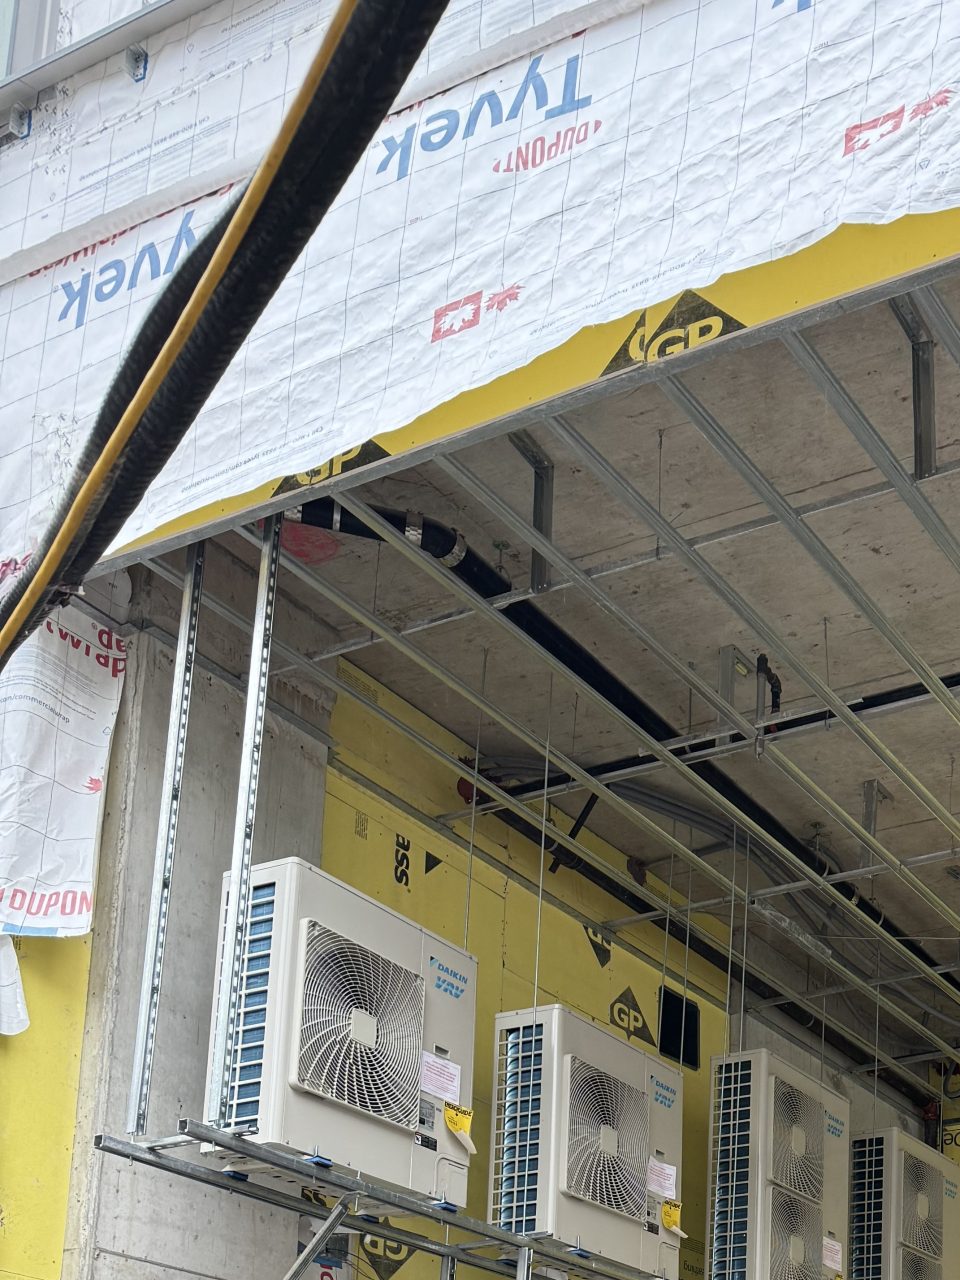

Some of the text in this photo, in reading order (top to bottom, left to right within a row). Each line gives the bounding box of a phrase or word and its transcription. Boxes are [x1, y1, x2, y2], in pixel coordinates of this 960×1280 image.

[375, 54, 596, 181] Tyvek
[501, 123, 589, 174] DUPONT
[58, 209, 199, 329] yvek
[647, 315, 723, 363] GP
[9, 888, 94, 917] DUPON
[437, 962, 468, 985] DAIKIN
[612, 1002, 644, 1032] GP
[655, 1080, 677, 1097] DAIKIN
